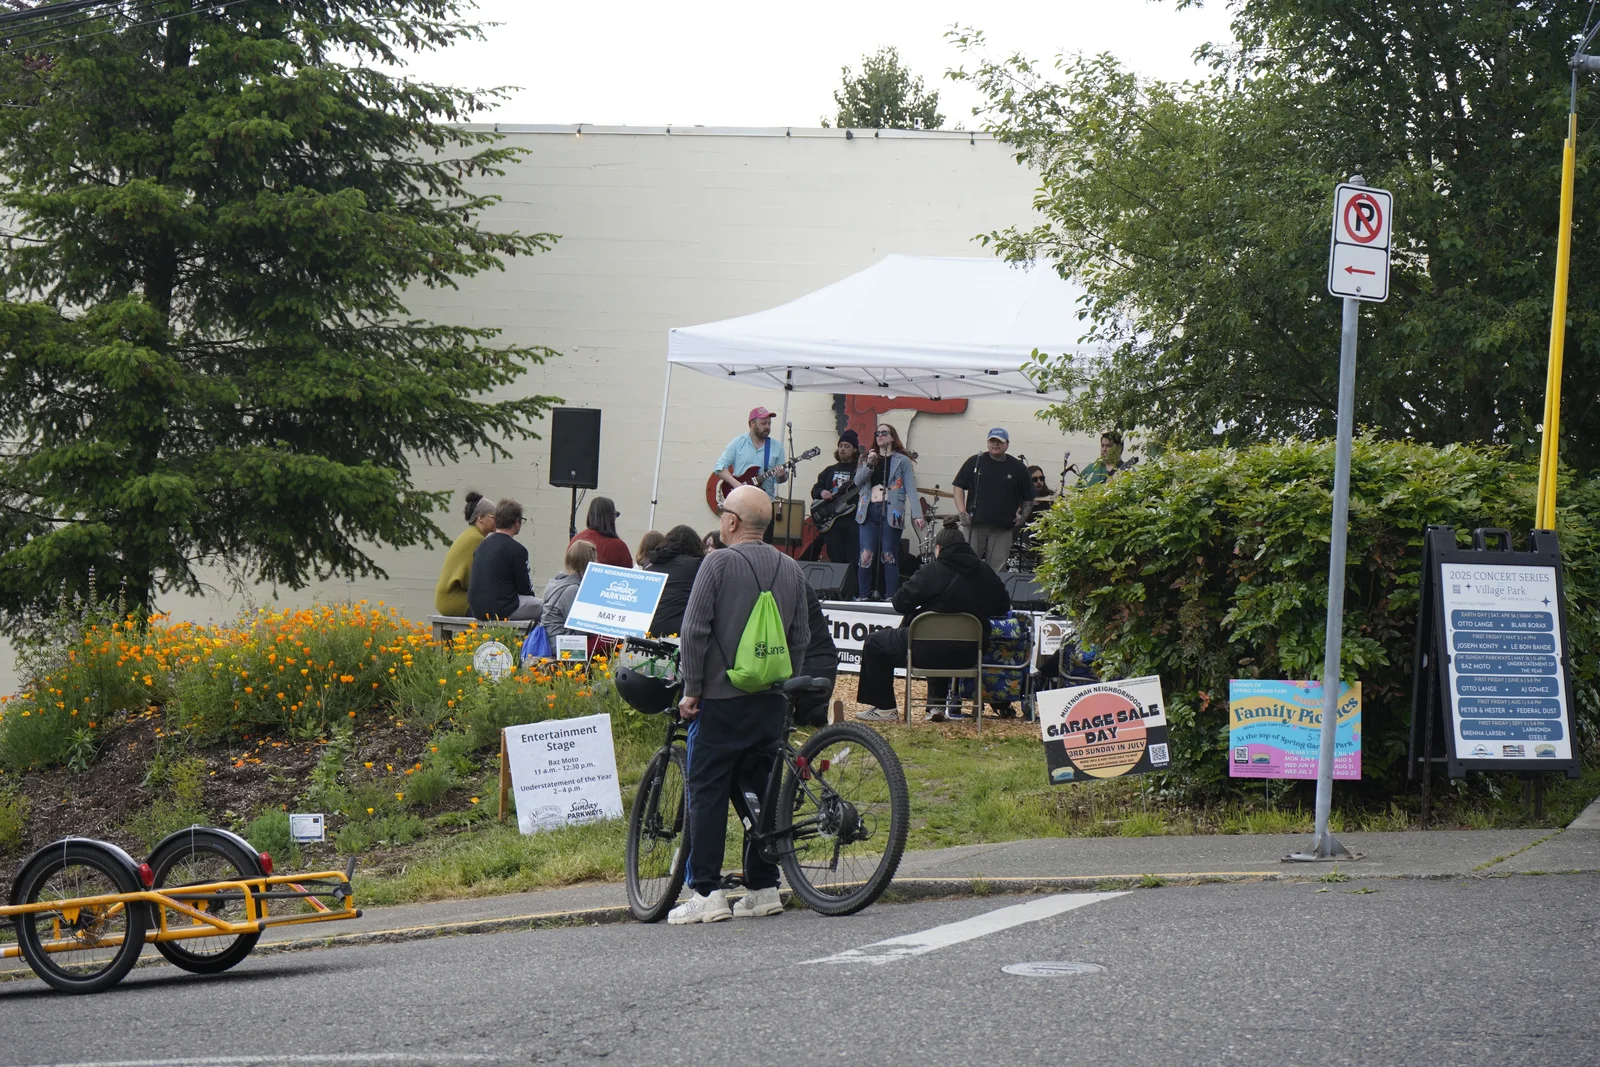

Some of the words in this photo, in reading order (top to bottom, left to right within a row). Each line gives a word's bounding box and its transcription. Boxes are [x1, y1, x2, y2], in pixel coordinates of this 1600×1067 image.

[604, 569, 645, 580] NEIGHBORHOOD
[1450, 571, 1472, 580] 2025
[1474, 572, 1516, 581] CONCERT
[1519, 573, 1550, 582] SERIES
[606, 580, 638, 594] Sunday
[1475, 585, 1504, 597] Village
[1507, 586, 1527, 596] Park
[600, 590, 638, 603] PARKWAYS
[598, 612, 616, 621] MAY
[1061, 688, 1092, 718] MULTNOMAH
[1093, 686, 1142, 708] NEIGHBORHOOD
[1234, 703, 1297, 724] Family
[1298, 697, 1358, 724] Picics
[1047, 713, 1114, 737] GARAGE
[1117, 704, 1160, 722] SALE
[521, 725, 598, 743] Entertainment
[1085, 727, 1118, 744] DAY
[547, 741, 576, 751] Stage
[1280, 736, 1306, 750] Spring
[1086, 746, 1115, 756] SUNDAY
[520, 779, 575, 792] Understatement
[568, 786, 582, 794] p.m.
[570, 799, 598, 812] Sunday
[568, 809, 603, 819] PARKWAYS
